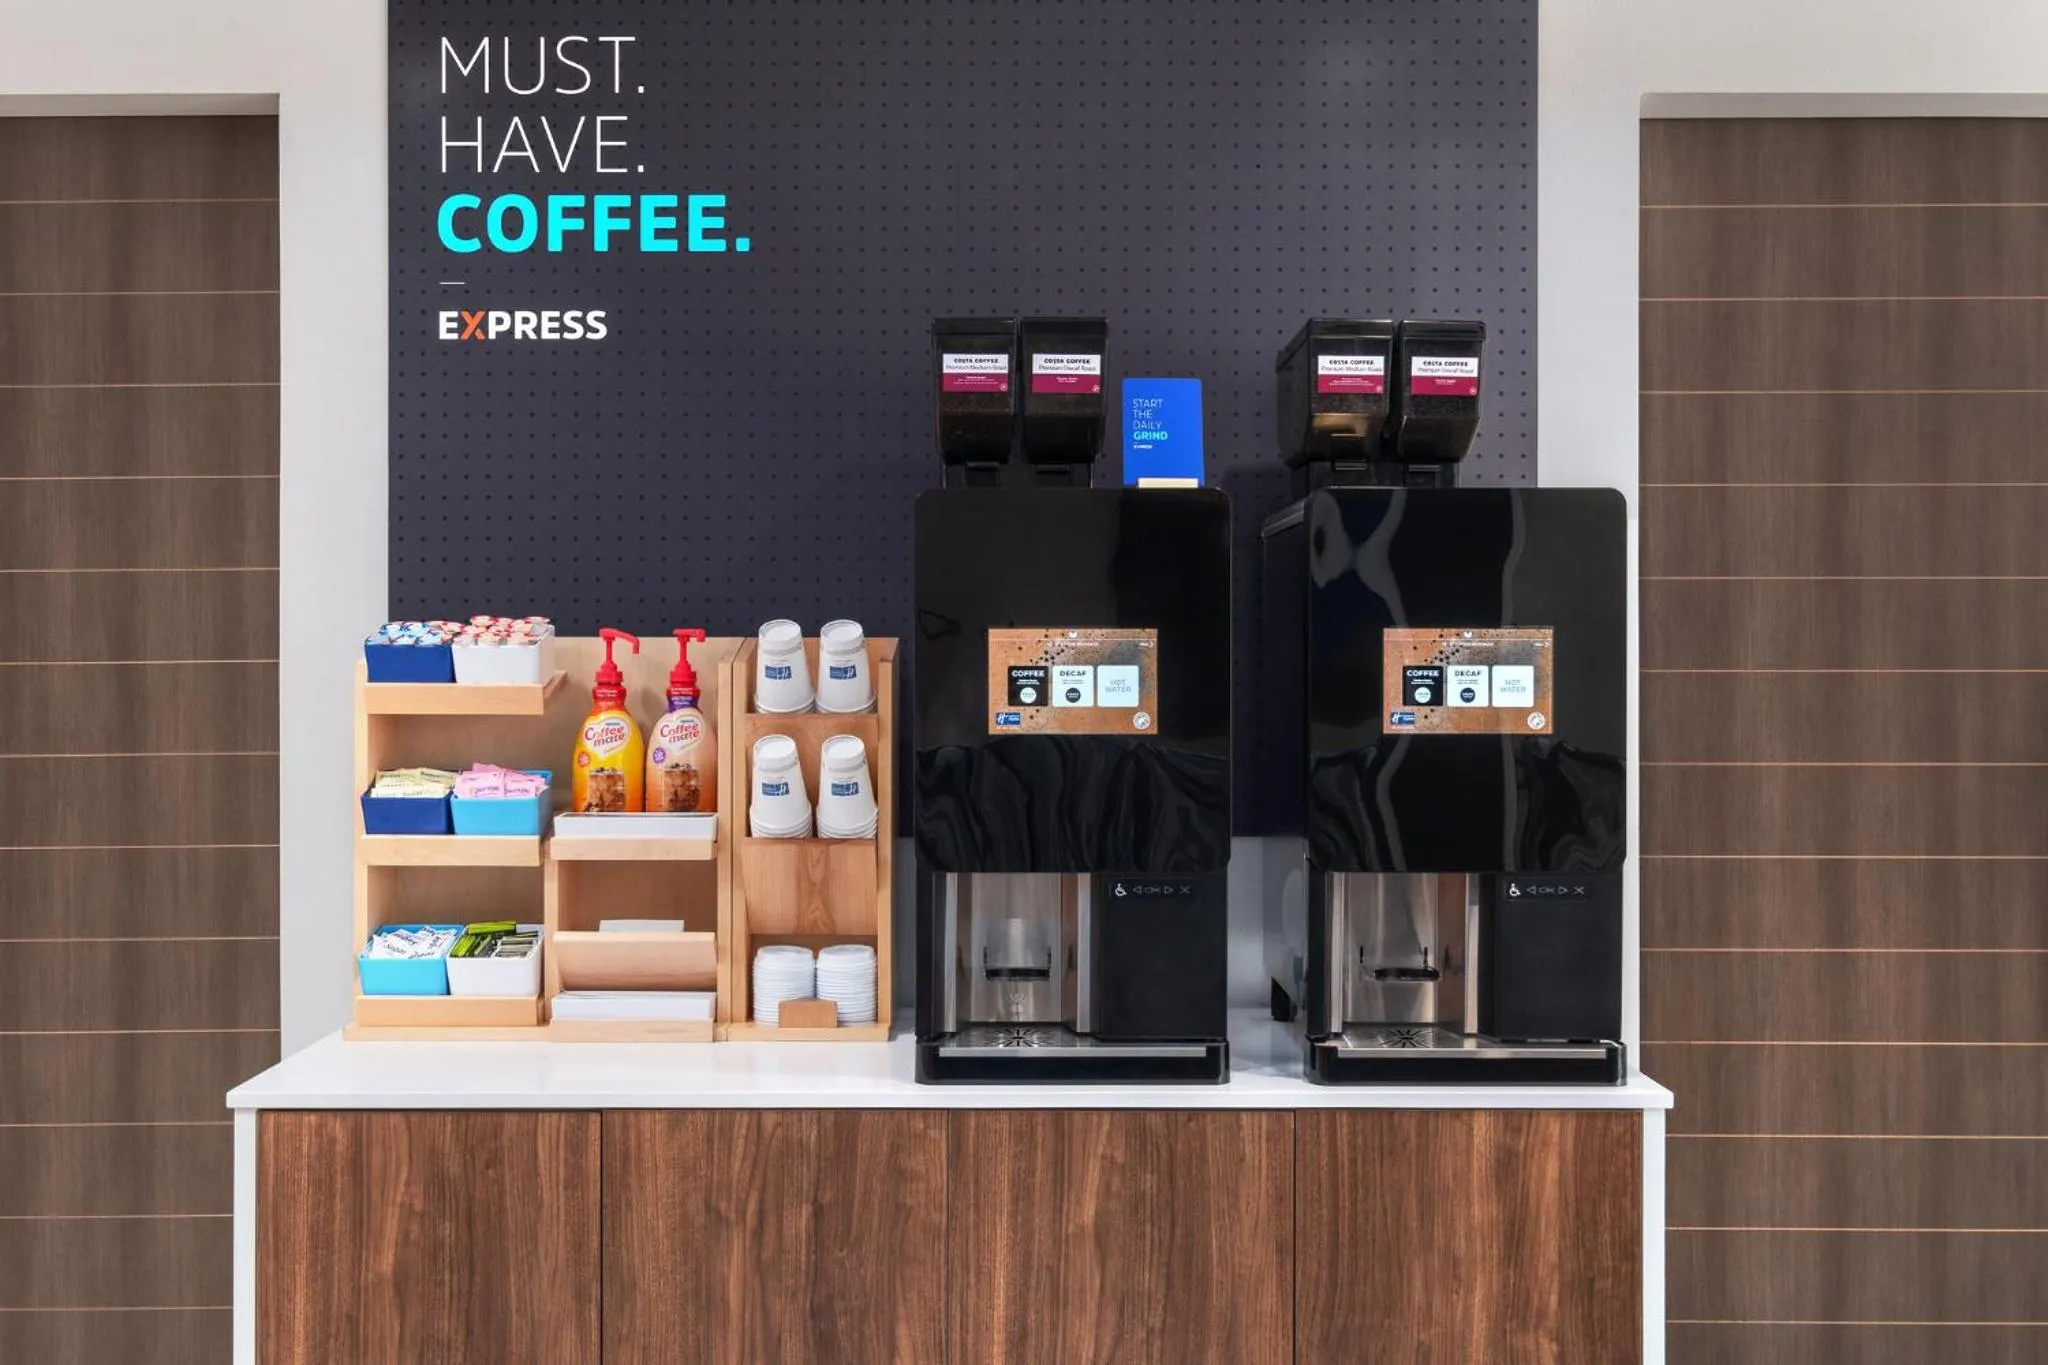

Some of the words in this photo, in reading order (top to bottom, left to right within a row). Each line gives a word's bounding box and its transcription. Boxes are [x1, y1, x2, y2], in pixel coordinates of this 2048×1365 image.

[441, 36, 645, 94] MUST.
[441, 116, 645, 173] HAVE.
[437, 193, 750, 253] COFFEE.
[438, 310, 608, 341] EXPRESS
[1132, 398, 1164, 408] START
[1133, 409, 1153, 418] THE
[1133, 420, 1162, 430] DAILY
[1133, 430, 1168, 441] GRIND
[1011, 669, 1045, 677] COFFEE
[1406, 669, 1440, 677] COFFEE
[1454, 669, 1482, 677] DECAF
[584, 726, 625, 740] Coffee
[660, 723, 700, 737] Coffee
[668, 730, 701, 743] mate
[593, 733, 626, 747] mate
